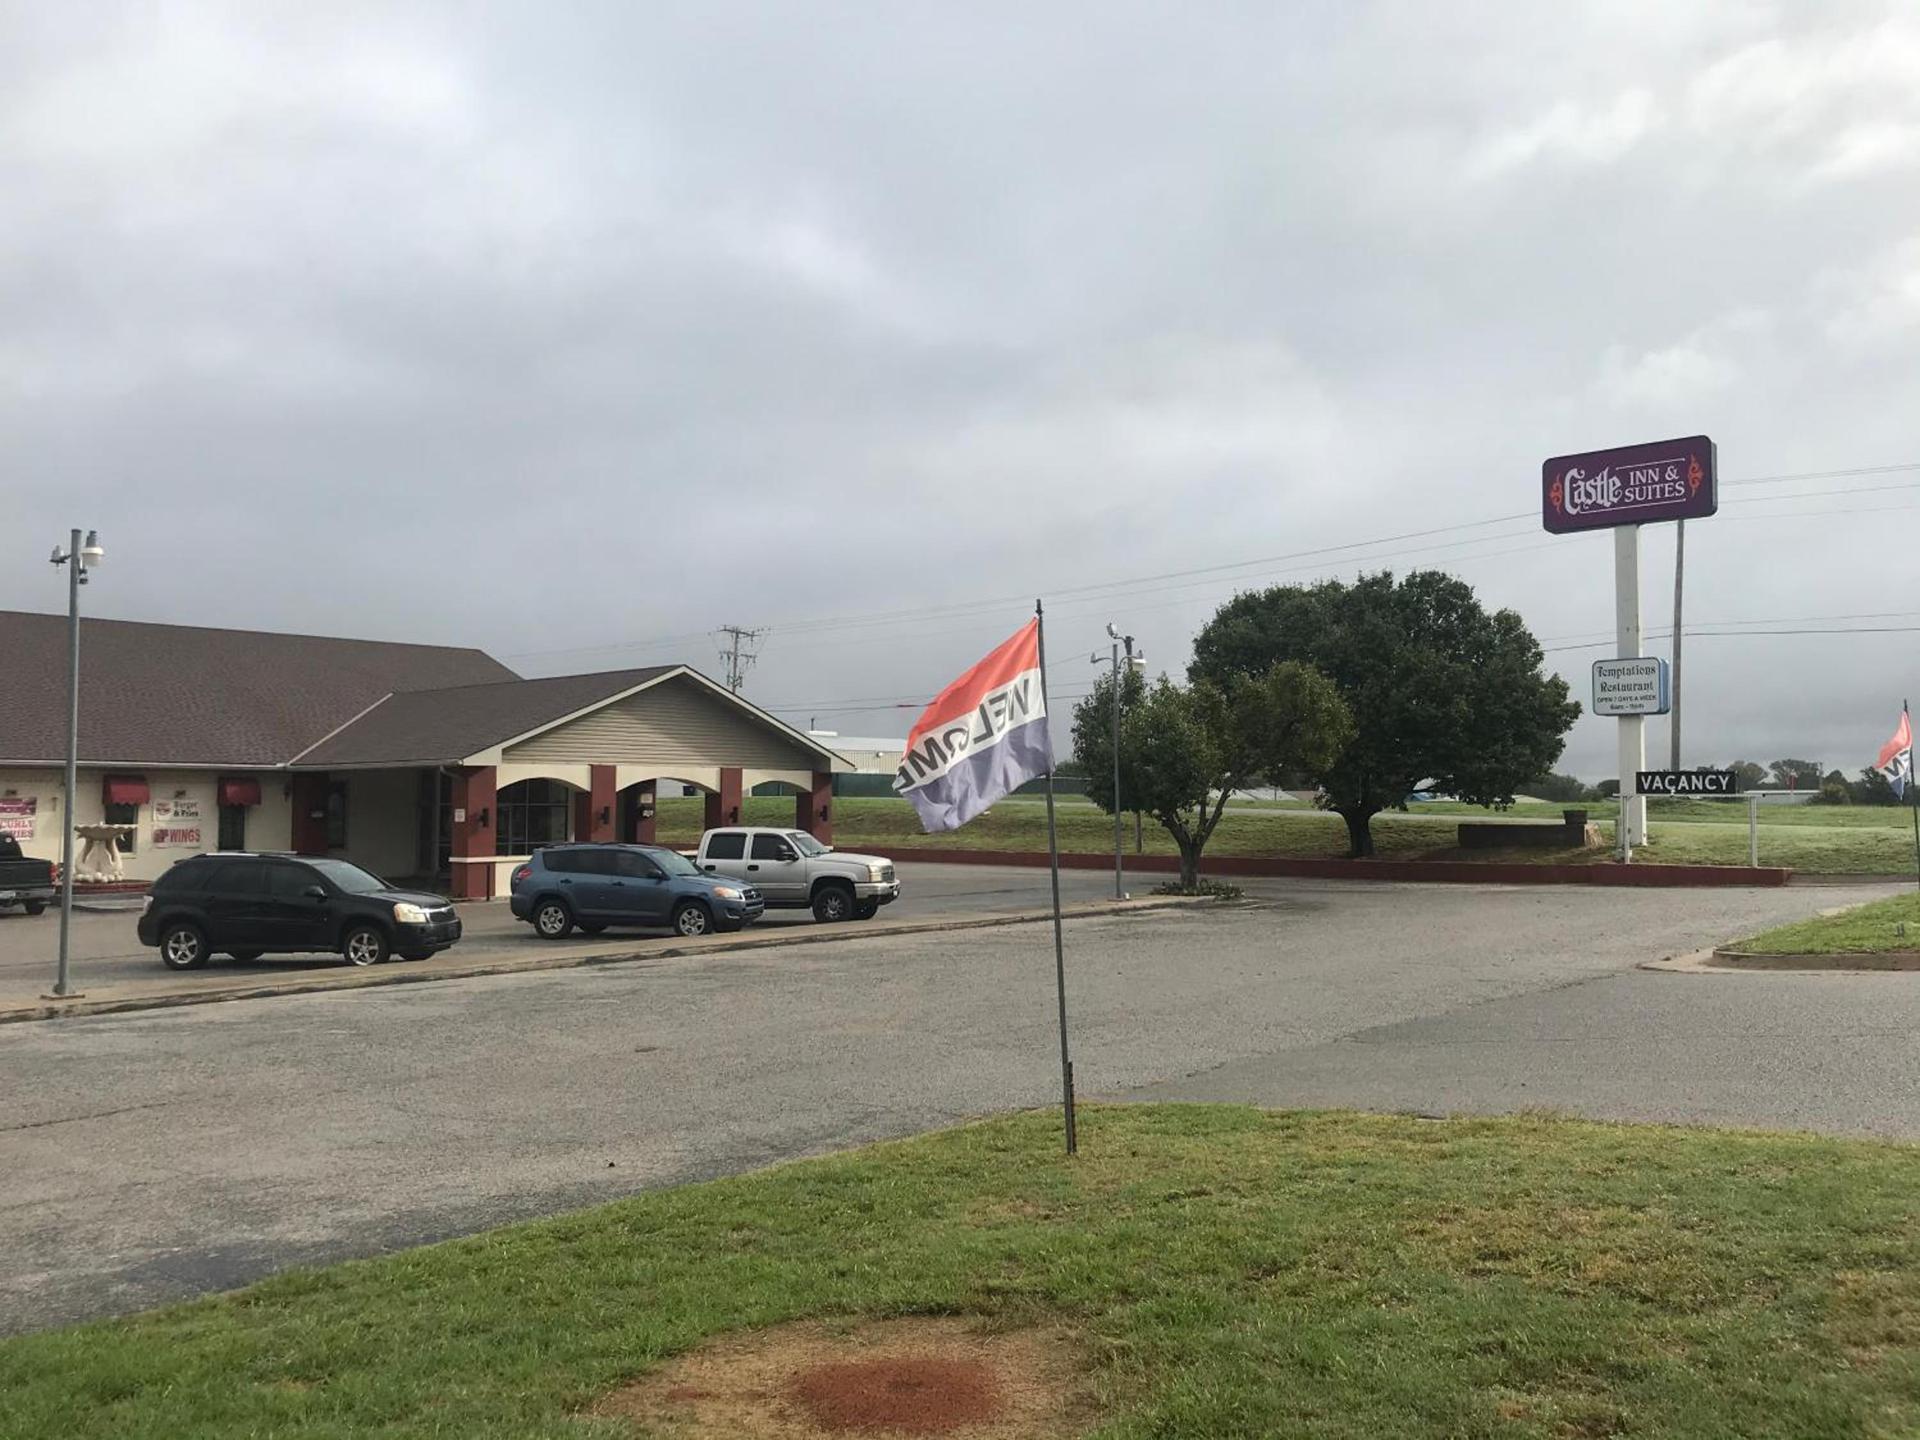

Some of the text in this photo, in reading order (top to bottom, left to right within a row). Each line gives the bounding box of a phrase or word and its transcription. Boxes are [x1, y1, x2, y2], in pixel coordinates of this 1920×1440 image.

[1630, 466, 1680, 486] INN &
[1564, 467, 1622, 515] Castle
[1624, 481, 1685, 503] SUITES
[1597, 666, 1656, 679] Temptations
[1600, 682, 1653, 692] Restaurant
[1641, 775, 1729, 790] VACANCY
[170, 829, 200, 842] WINGS
